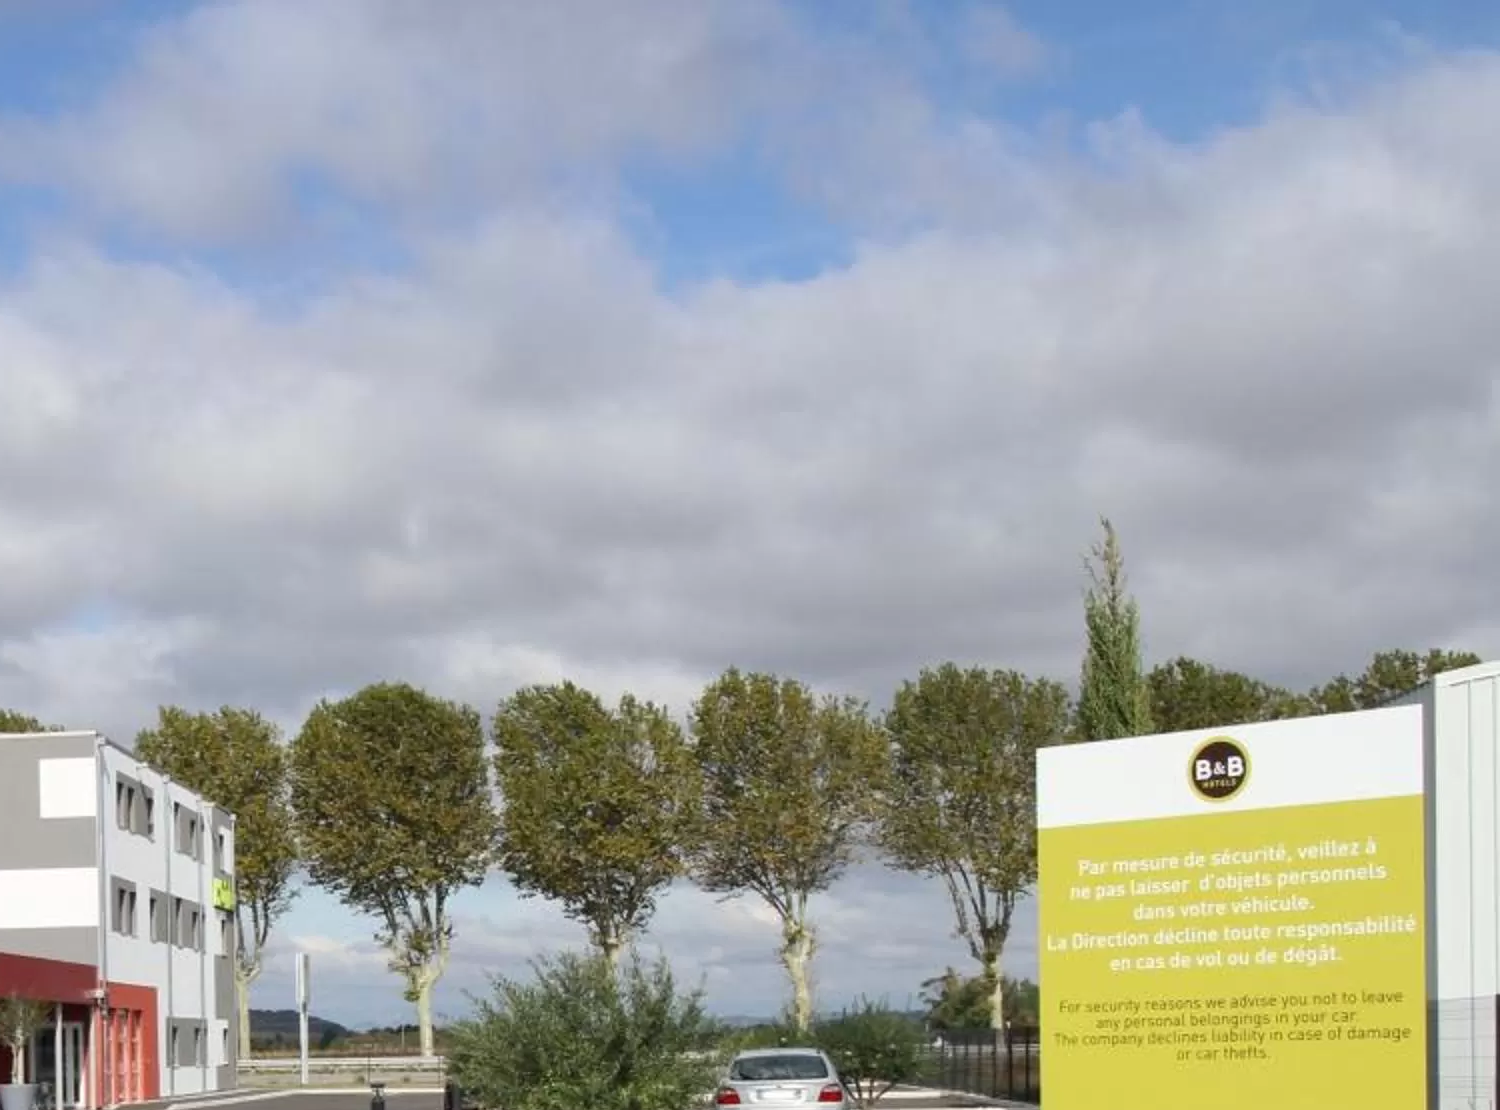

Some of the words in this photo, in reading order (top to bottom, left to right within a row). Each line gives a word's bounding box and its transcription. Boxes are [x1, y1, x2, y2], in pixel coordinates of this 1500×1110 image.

[1195, 756, 1244, 780] B&B
[1078, 859, 1106, 876] Par
[1113, 856, 1179, 873] mesure
[1184, 851, 1205, 867] de
[1212, 843, 1292, 866] sécurité,
[1297, 839, 1360, 860] veillez
[1070, 886, 1091, 900] ne
[1096, 883, 1125, 901] pas
[1131, 879, 1190, 896] laisser
[1200, 872, 1272, 892] d'objets
[1278, 863, 1387, 891] personnels
[1134, 904, 1175, 920] dans
[1181, 902, 1226, 917] votre
[1231, 894, 1315, 914] véhicule.
[1047, 936, 1067, 951] La
[1072, 931, 1149, 950] Direction
[1154, 927, 1218, 945] décline
[1224, 924, 1271, 941] toute
[1278, 914, 1416, 941] responsabilité
[1110, 958, 1131, 972] en
[1136, 956, 1165, 969] cas
[1169, 952, 1191, 968] de
[1196, 951, 1221, 967] vol
[1227, 953, 1249, 965] ou
[1255, 948, 1277, 964] de
[1059, 1000, 1081, 1013] For
[1085, 999, 1140, 1014] security
[1145, 998, 1200, 1010] reasons
[1206, 998, 1225, 1009] we
[1230, 994, 1277, 1008] advise
[1281, 995, 1307, 1010] you
[1313, 992, 1337, 1005] not
[1342, 992, 1357, 1004] to
[1362, 990, 1404, 1003] leave
[1096, 1017, 1121, 1031] any
[1124, 1014, 1186, 1031] personal
[1190, 1013, 1270, 1028] belongings
[1275, 1012, 1289, 1024] in
[1293, 1012, 1325, 1026] your
[1054, 1033, 1078, 1046] The
[1082, 1033, 1143, 1047] company
[1148, 1030, 1206, 1045] declines
[1211, 1029, 1265, 1044] liability
[1269, 1029, 1283, 1041] in
[1287, 1029, 1323, 1041] case
[1327, 1026, 1342, 1040] of
[1347, 1026, 1411, 1042] damage
[1176, 1050, 1191, 1061] or
[1196, 1049, 1219, 1060] car
